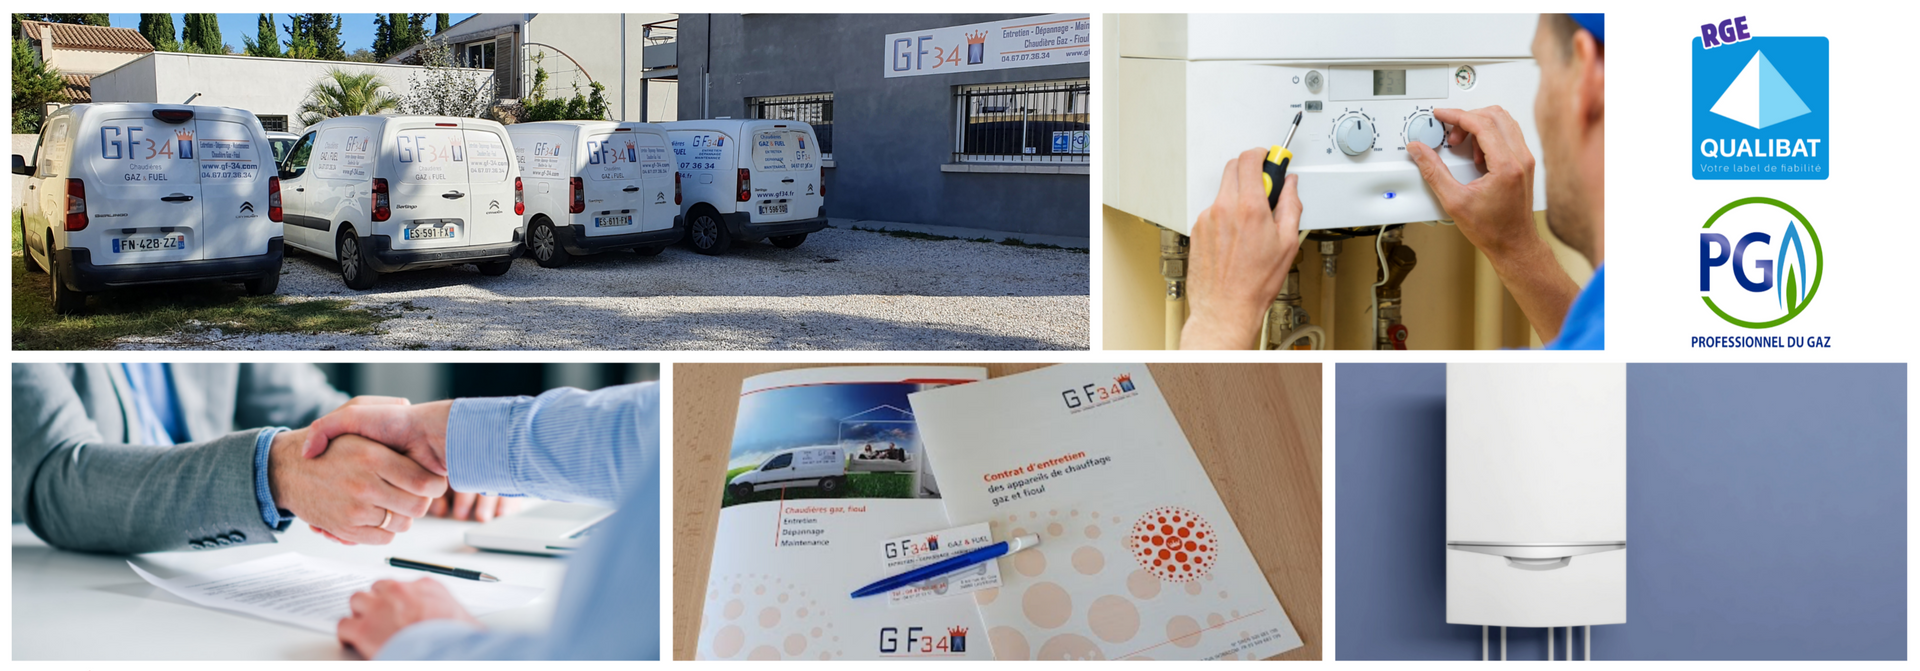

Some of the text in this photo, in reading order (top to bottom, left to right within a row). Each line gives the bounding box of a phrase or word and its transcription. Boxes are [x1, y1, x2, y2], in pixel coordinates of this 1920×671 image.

[1003, 28, 1030, 38] Entretien
[1036, 26, 1068, 36] Dépannage
[1024, 38, 1055, 48] Chaudière
[1056, 36, 1068, 44] Gaz
[1074, 34, 1090, 43] Fioul
[1002, 52, 1050, 62] 04.67.07.36.34
[124, 174, 141, 182] GAZ
[148, 173, 168, 181] FUEL
[984, 450, 1086, 482] Contrat d'entretien
[988, 455, 1111, 494] des appareils de chauffage
[992, 485, 1046, 507] gaz et fioul
[785, 506, 827, 514] Chaudières
[971, 536, 988, 544] FUEL
